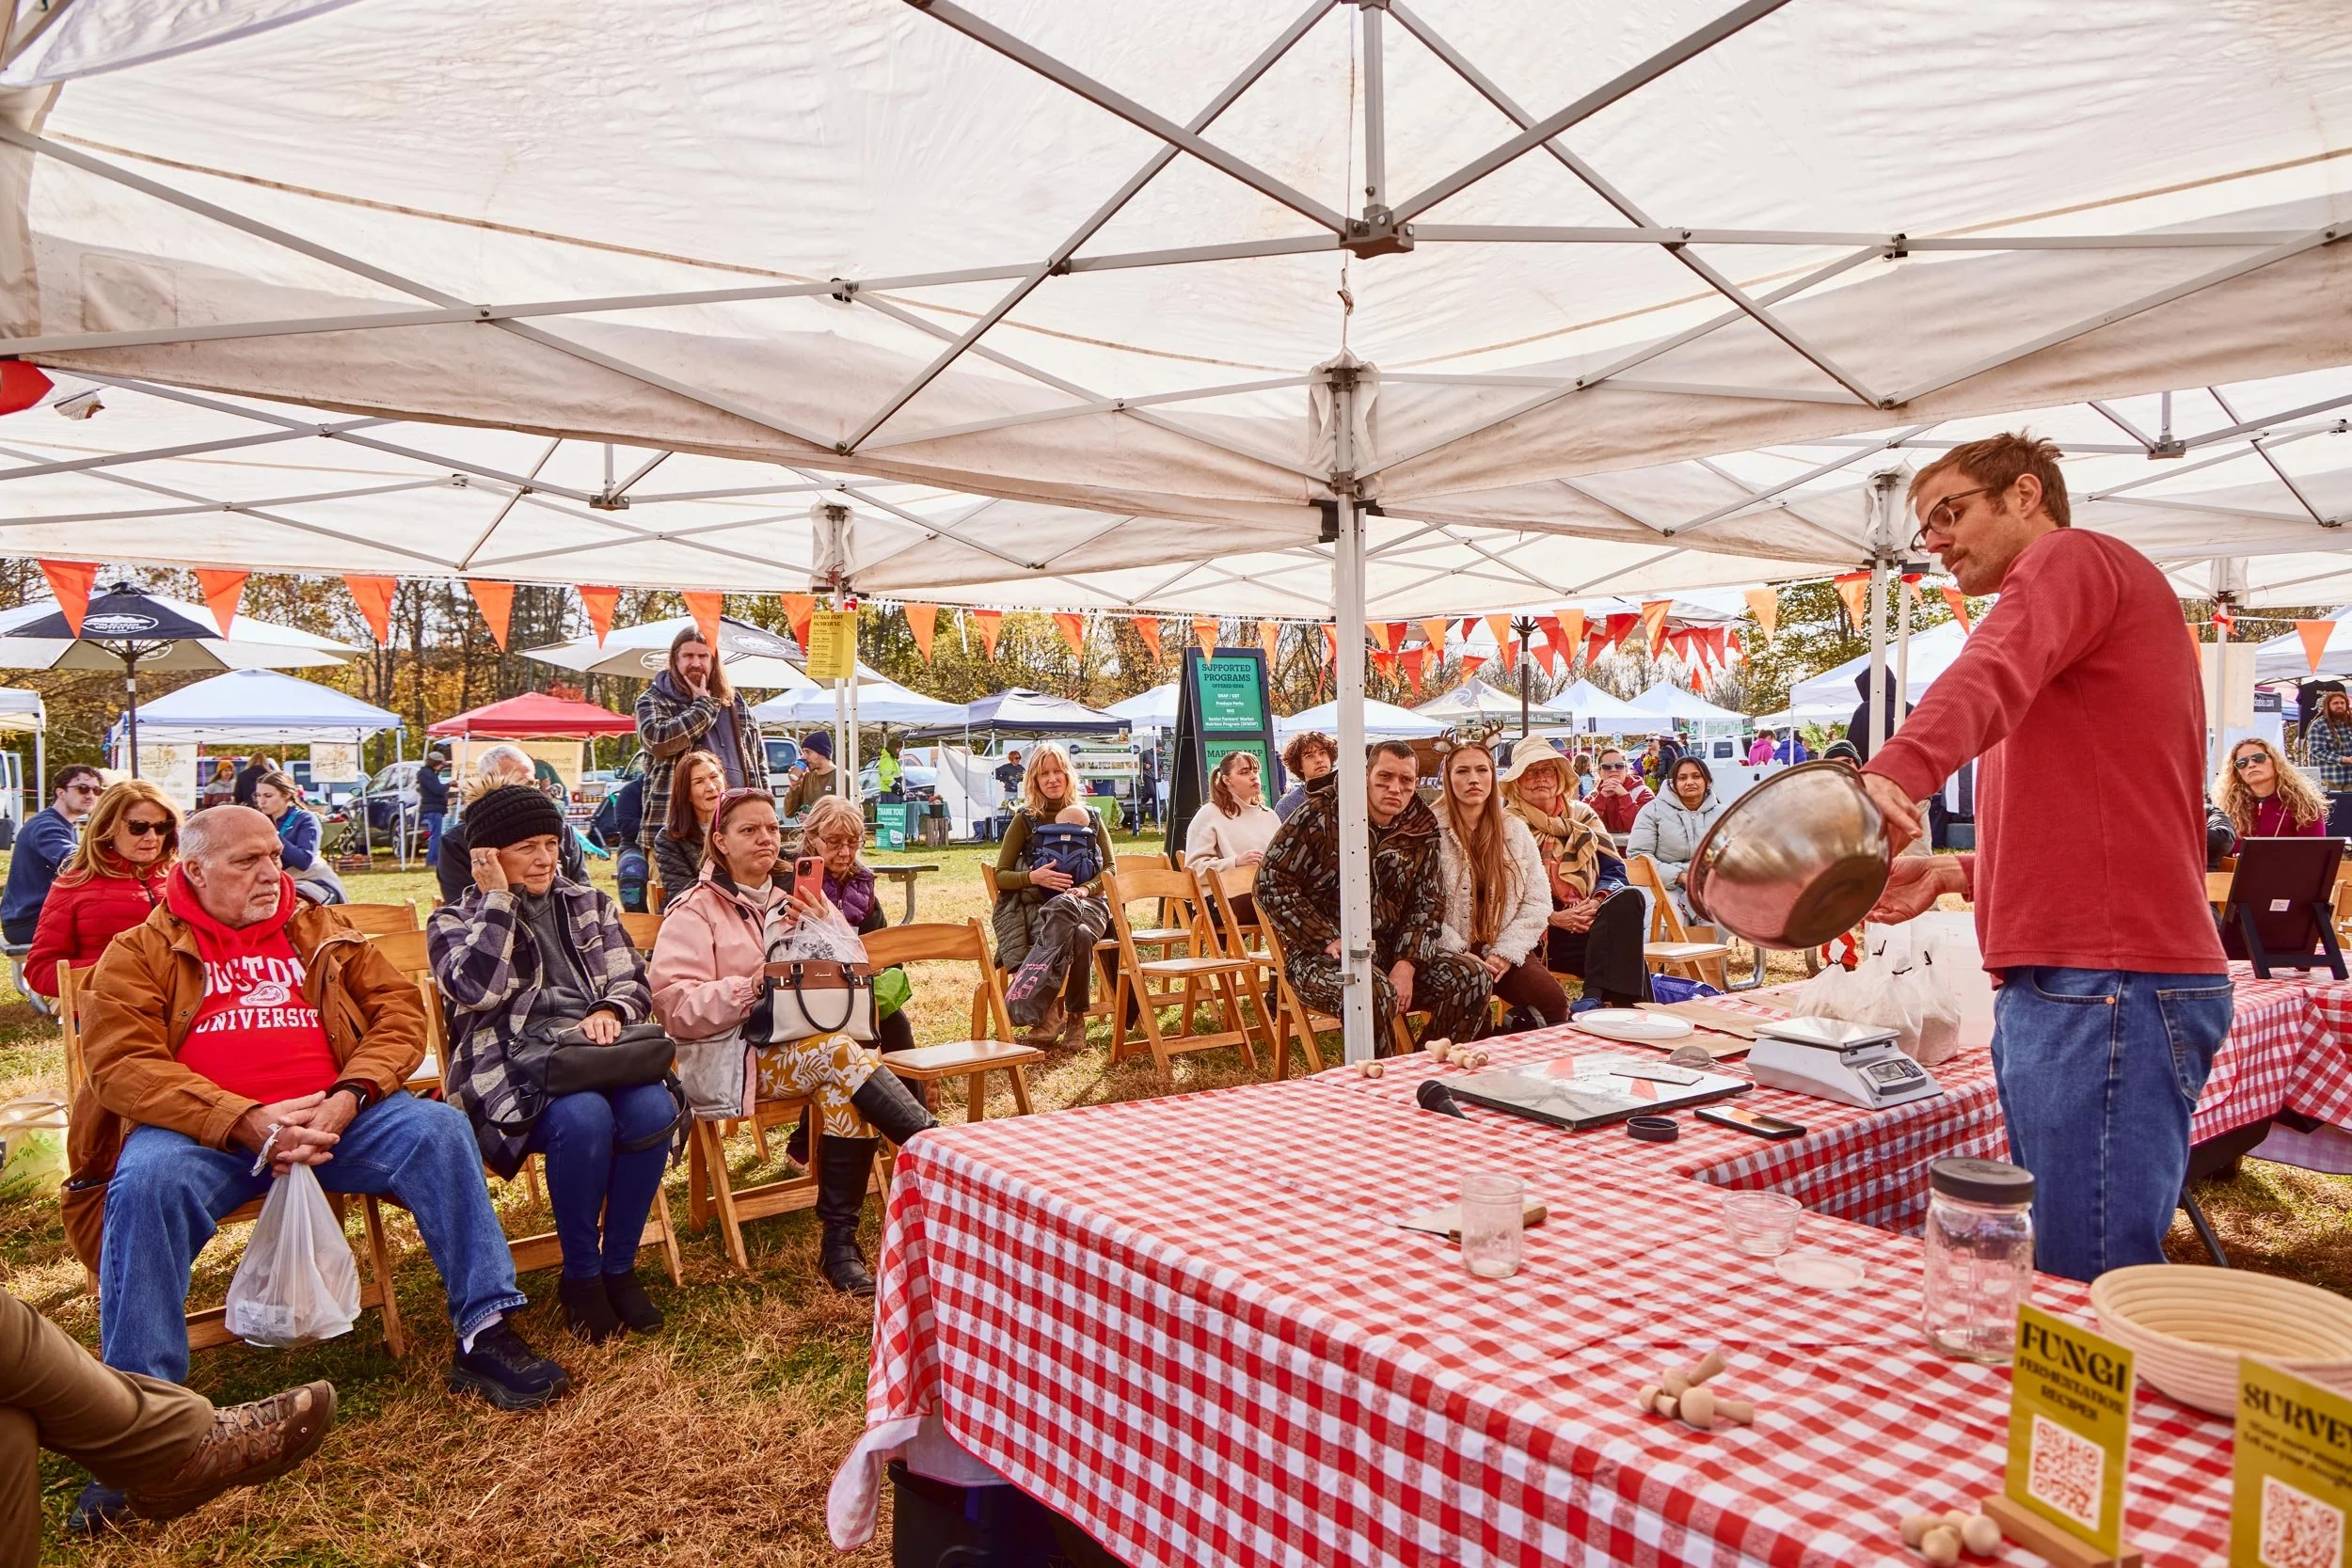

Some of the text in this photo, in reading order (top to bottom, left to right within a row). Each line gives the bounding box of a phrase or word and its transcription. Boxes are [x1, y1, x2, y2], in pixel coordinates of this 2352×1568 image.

[1201, 663, 1251, 672] SUPPORTED
[1203, 673, 1251, 682] PROGRAMS
[196, 1007, 319, 1034] UNIVERSIT
[2022, 1321, 2125, 1392] FUNGI
[2019, 1355, 2124, 1416] FERMENTATION
[2041, 1384, 2099, 1422] RECIPES
